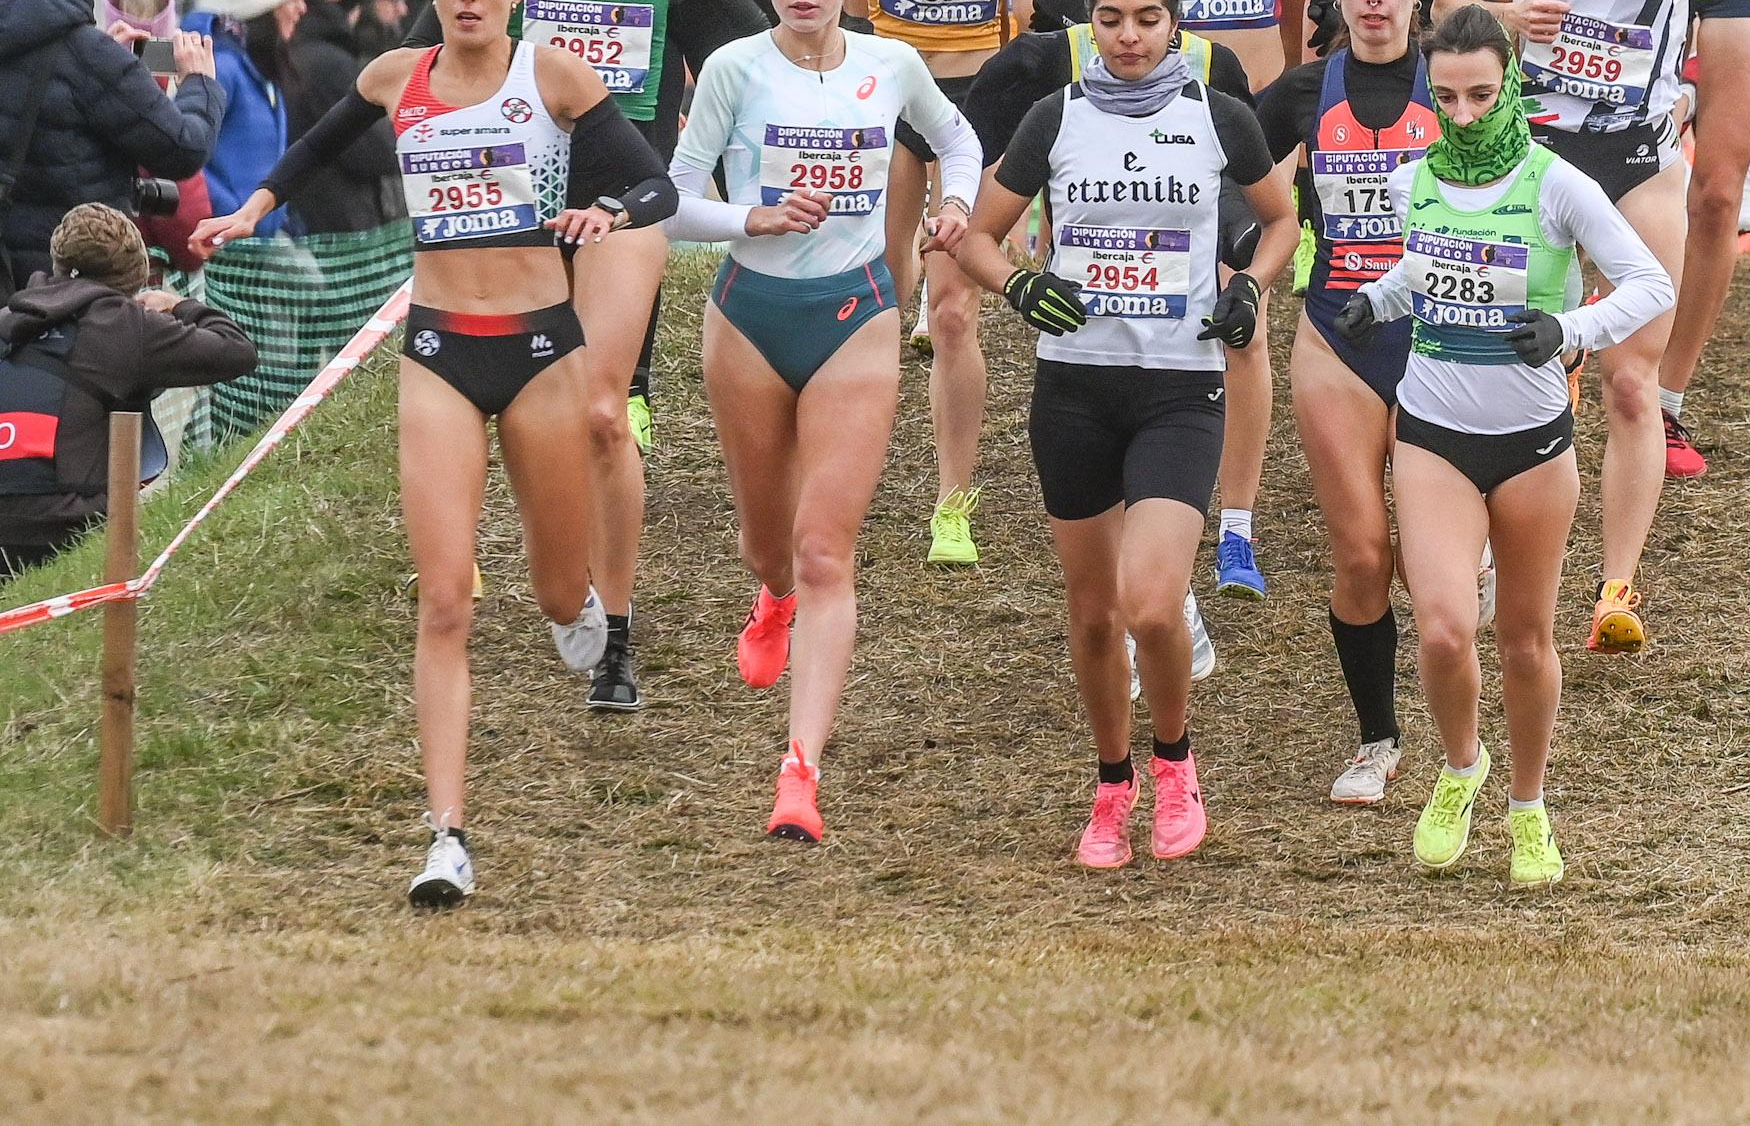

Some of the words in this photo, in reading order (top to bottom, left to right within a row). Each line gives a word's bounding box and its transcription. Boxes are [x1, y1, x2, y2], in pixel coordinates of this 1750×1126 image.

[537, 0, 603, 14] DIPUTACIÓN
[912, 3, 983, 22] Joma
[537, 11, 602, 23] BURGOS
[1563, 13, 1608, 30] UTACIÓN
[557, 24, 600, 36] Ibercaja
[1564, 24, 1606, 40] RGOS
[1560, 33, 1602, 51] Ibercaja
[1549, 46, 1622, 83] 2959
[1554, 75, 1626, 104] Joma
[439, 128, 473, 138] super
[474, 126, 511, 135] amara
[777, 128, 844, 139] DIPUTACIÓN
[777, 138, 844, 148] BURGOS
[409, 149, 472, 164] DIPUTACIÓN
[798, 151, 842, 162] Ibercaja
[1325, 152, 1388, 164] DIPUTACIÓN
[1625, 155, 1657, 166] VIATOR
[410, 159, 472, 173] BURGOS
[1325, 163, 1388, 173] BURGOS
[431, 171, 473, 183] Ibercaja
[790, 164, 863, 189] 2958
[1346, 175, 1388, 185] Ibercaja
[428, 181, 502, 212] 2955
[1067, 175, 1201, 205] etxenike
[829, 194, 873, 213] ma
[1344, 189, 1392, 213] 175
[441, 209, 520, 239] Joma
[1355, 216, 1402, 237] Jom
[1071, 227, 1137, 240] DIPUTACIÓN
[1452, 228, 1497, 237] Fundación
[1072, 238, 1136, 249] BURGOS
[1418, 232, 1473, 252] DIPUTACIÓN
[1092, 250, 1135, 262] Ibercaja
[1416, 242, 1473, 261] BURGOS
[1364, 257, 1398, 271] Saul
[1431, 259, 1471, 274] Ibercaja
[1086, 263, 1159, 291] 2954
[1424, 272, 1495, 304] 2283
[1093, 294, 1169, 315] Joma
[1433, 301, 1507, 326] Joma
